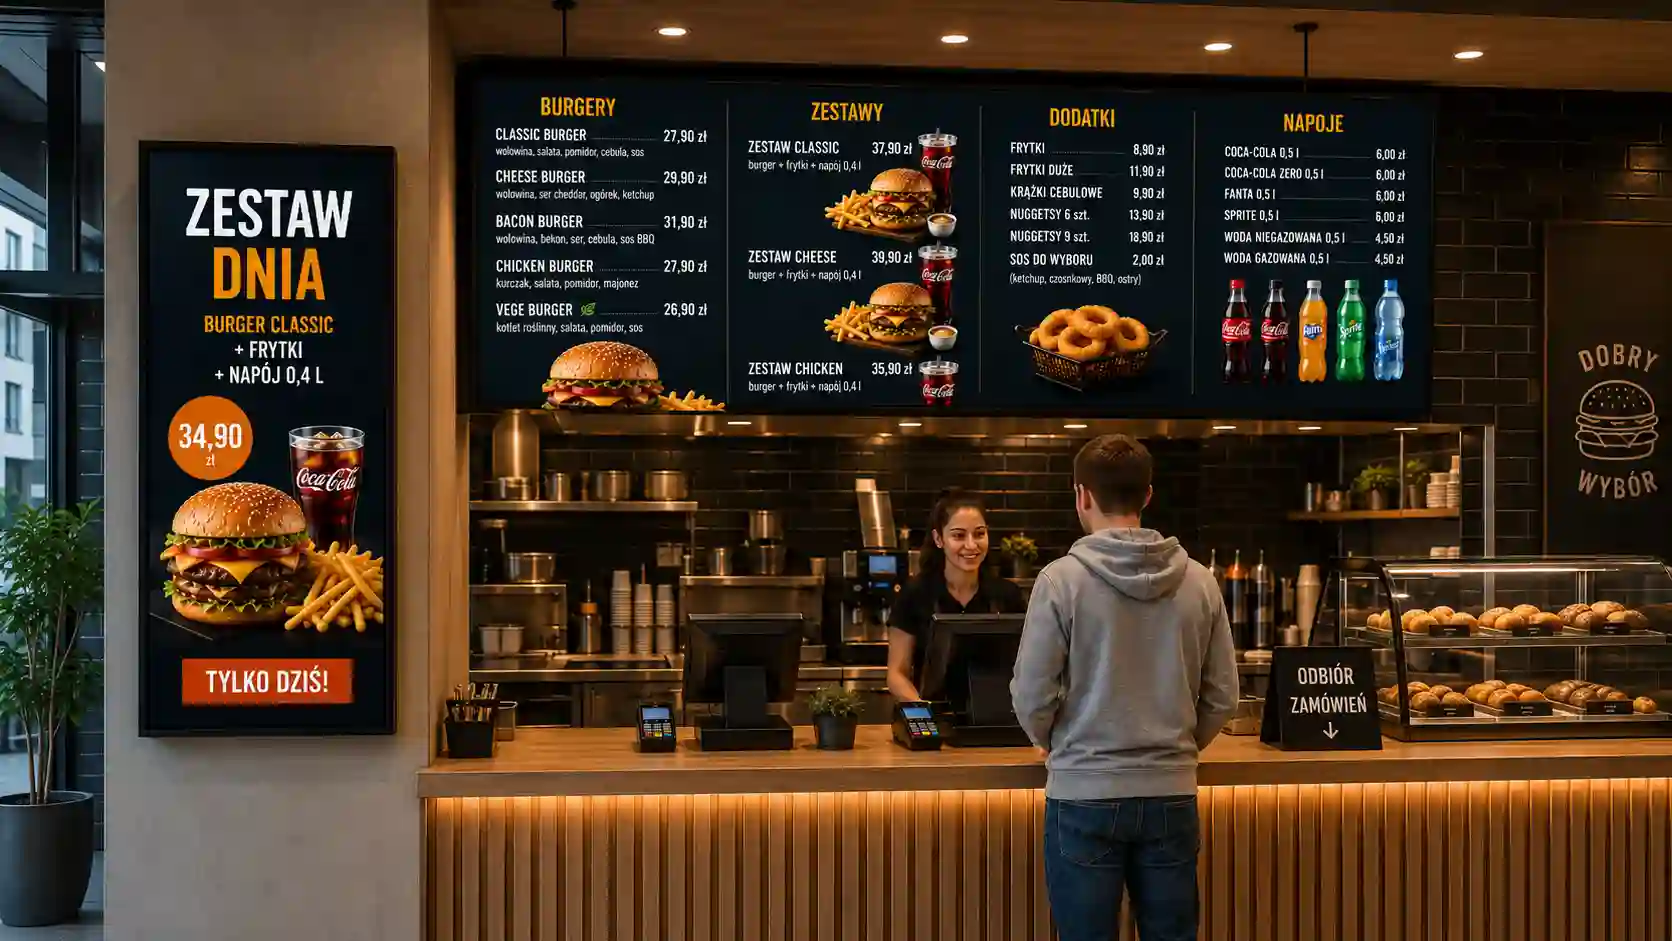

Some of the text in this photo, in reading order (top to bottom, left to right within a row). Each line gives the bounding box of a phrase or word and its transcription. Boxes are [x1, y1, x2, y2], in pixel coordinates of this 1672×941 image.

[541, 97, 615, 116] BURGERY
[812, 102, 883, 121] ZESTAWY
[1050, 108, 1114, 127] DODATKI
[1284, 114, 1343, 132] NAPOJE
[496, 128, 707, 144] CLASSIC BURGER 27,90 zł
[749, 140, 912, 155] ZESTAW CLASSIC 37,90 zł
[1011, 142, 1044, 153] FRYTKI
[1134, 144, 1154, 156] 8,90
[1225, 146, 1276, 158] COCA-COLA
[1280, 148, 1293, 159] 0,5
[1377, 149, 1395, 160] 6,00
[748, 160, 776, 172] burger
[787, 160, 808, 172] frytki
[819, 160, 840, 172] napój
[844, 161, 856, 172] 0,4
[1011, 164, 1044, 175] FRYTKI
[1049, 162, 1073, 175] DUŻE
[1130, 165, 1153, 177] 11,90
[1225, 167, 1276, 178] COCA-COLA
[1280, 168, 1302, 179] ZERO
[1305, 169, 1318, 180] 0,5
[1376, 169, 1395, 180] 6,00
[496, 170, 707, 185] CHEESE BURGER 29,90 zł
[539, 191, 551, 199] ser
[623, 189, 654, 201] ketchup
[1011, 185, 1046, 200] KRĄŻKI
[1050, 187, 1102, 198] CEBULOWE
[1133, 188, 1153, 199] 9,90
[1225, 188, 1253, 199] FANTA
[1257, 189, 1270, 200] 0,5
[1376, 190, 1395, 201] 6,00
[186, 188, 352, 238] ZESTAW
[1011, 208, 1061, 219] NUGGETSY
[1065, 209, 1070, 219] 6
[1074, 210, 1089, 220] szt.
[1130, 209, 1153, 221] 13,90
[1225, 210, 1256, 220] SPRITE
[1260, 210, 1273, 222] 0,5
[1376, 212, 1394, 223] 6,00
[496, 215, 707, 230] BACON BURGER 31,90 zł
[621, 236, 634, 244] sos
[1011, 230, 1061, 242] NUGGETSY
[1065, 231, 1070, 242] 9
[1074, 232, 1090, 242] szt.
[1129, 231, 1153, 243] 18,90
[1225, 232, 1251, 242] WODA
[1256, 232, 1322, 243] NIEGAZOWANA
[1326, 232, 1339, 244] 0,5
[1376, 233, 1394, 244] 4,50
[748, 250, 912, 265] ZESTAW CHEESE 39,90 zł
[1010, 253, 1029, 265] SOS
[1033, 254, 1046, 265] DO
[1050, 254, 1092, 265] WYBORU
[1133, 254, 1153, 266] 2,00
[1224, 252, 1251, 263] WODA
[1255, 253, 1306, 263] GAZOWANA
[1310, 253, 1323, 265] 0,5
[1375, 254, 1394, 265] 4,50
[214, 247, 325, 300] DNIA
[496, 260, 707, 274] CHICKEN BURGER 27,90 zł
[604, 278, 638, 290] majonez
[1010, 273, 1046, 285] (ketchup,
[1118, 274, 1141, 285] ostry)
[496, 303, 707, 317] VEGE BURGER 26,90 zł
[205, 316, 333, 333] BURGER CLASSIC
[497, 322, 520, 332] kotlet
[250, 341, 302, 358] FRYTKI
[1578, 344, 1659, 372] DOBRY
[230, 362, 280, 384] NAPÓJ
[287, 366, 310, 386] 0,4
[316, 367, 323, 383] L
[749, 362, 912, 376] ZESTAW CHICKEN 35,90 zł
[179, 423, 242, 452] 34,90
[205, 455, 215, 466] zł
[1578, 468, 1658, 499] WYBÓR
[206, 665, 328, 693] TYLKO DZIŚ!
[1298, 663, 1354, 684] ODBIÓR
[1291, 692, 1366, 713] ZAMÓWIEŃ
